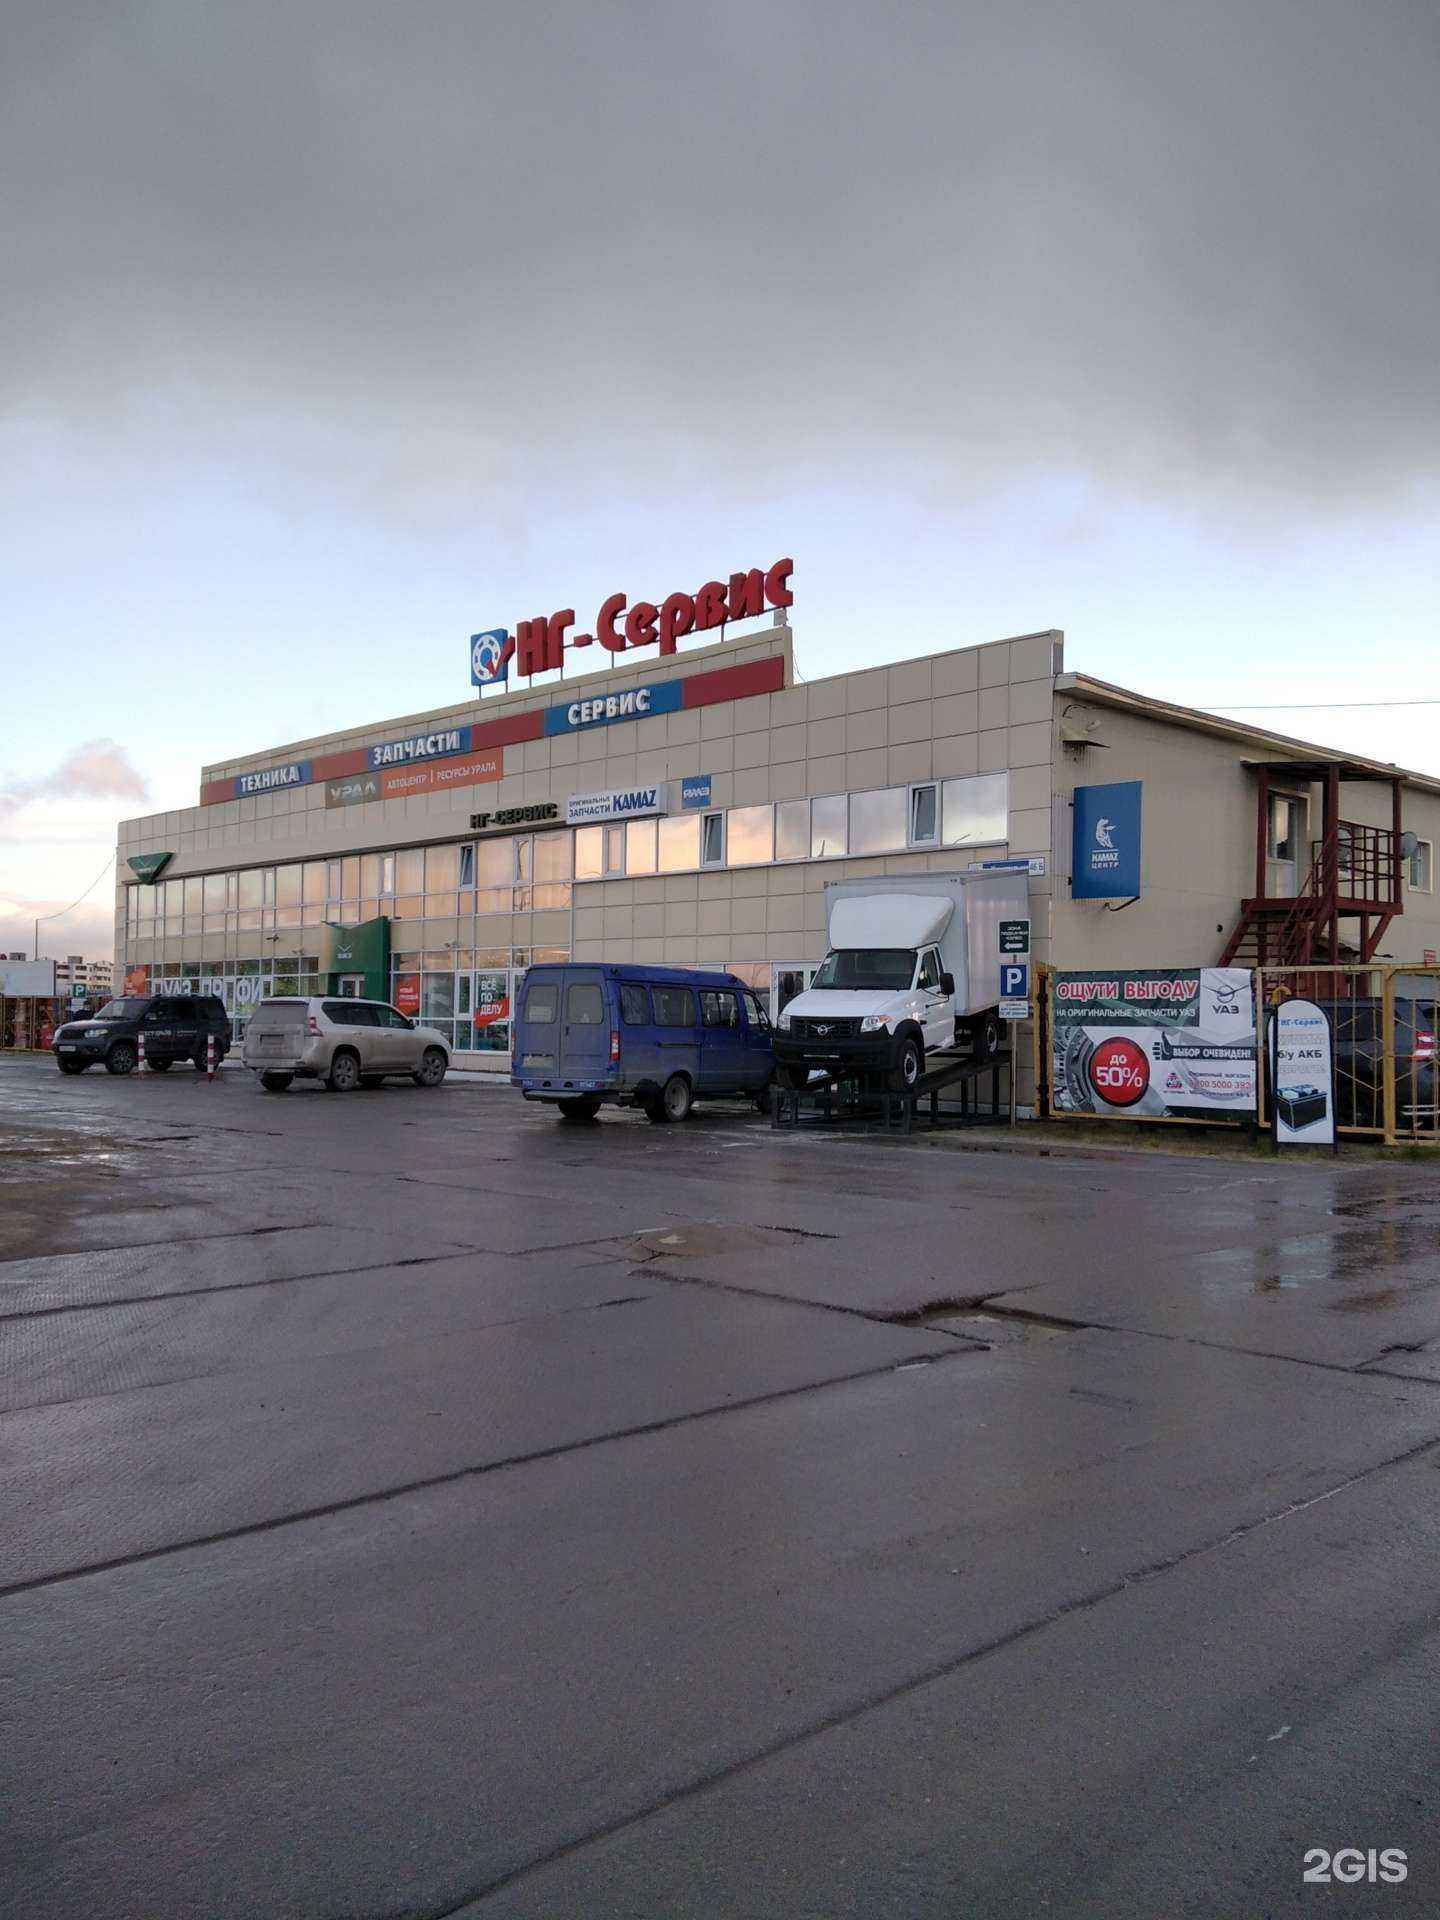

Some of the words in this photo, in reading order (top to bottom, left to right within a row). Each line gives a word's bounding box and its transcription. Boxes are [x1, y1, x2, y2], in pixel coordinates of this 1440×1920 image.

[517, 558, 793, 676] НГ-Сервис
[568, 688, 650, 725] СЕРВИС
[373, 731, 460, 765] ЗАПЧАСТИ
[240, 765, 300, 792] ТЕХНИКА
[387, 775, 427, 790] АВТОЦЕНТР
[436, 766, 470, 781] РЕСУРСЫ
[470, 761, 496, 777] УРАЛА
[330, 781, 376, 800] УРАЛ
[613, 789, 656, 812] KAMAZ
[470, 803, 558, 829] НГ-СЕРВИС
[569, 804, 611, 818] ЗАПЧАСТИ
[1092, 862, 1120, 870] ЦЕНТР
[1007, 968, 1022, 993] P
[1057, 981, 1118, 1001] ОЩУТИ
[1124, 979, 1199, 1001] ВЫГОДУ
[480, 1004, 502, 1016] ДЕЛУ
[1056, 1008, 1067, 1016] НА
[1067, 1008, 1133, 1017] ОРИГИНАЛЬНЫЕ
[1134, 1008, 1178, 1017] ЗАПЧАСТИ
[1180, 1007, 1196, 1017] УАЗ
[1212, 1005, 1240, 1014] УАЗ
[1173, 1048, 1200, 1057] ВЫБОР
[1202, 1048, 1251, 1059] ОЧЕВИДЕН!
[1298, 1050, 1322, 1059] АКБ
[1096, 1066, 1144, 1087] 50%
